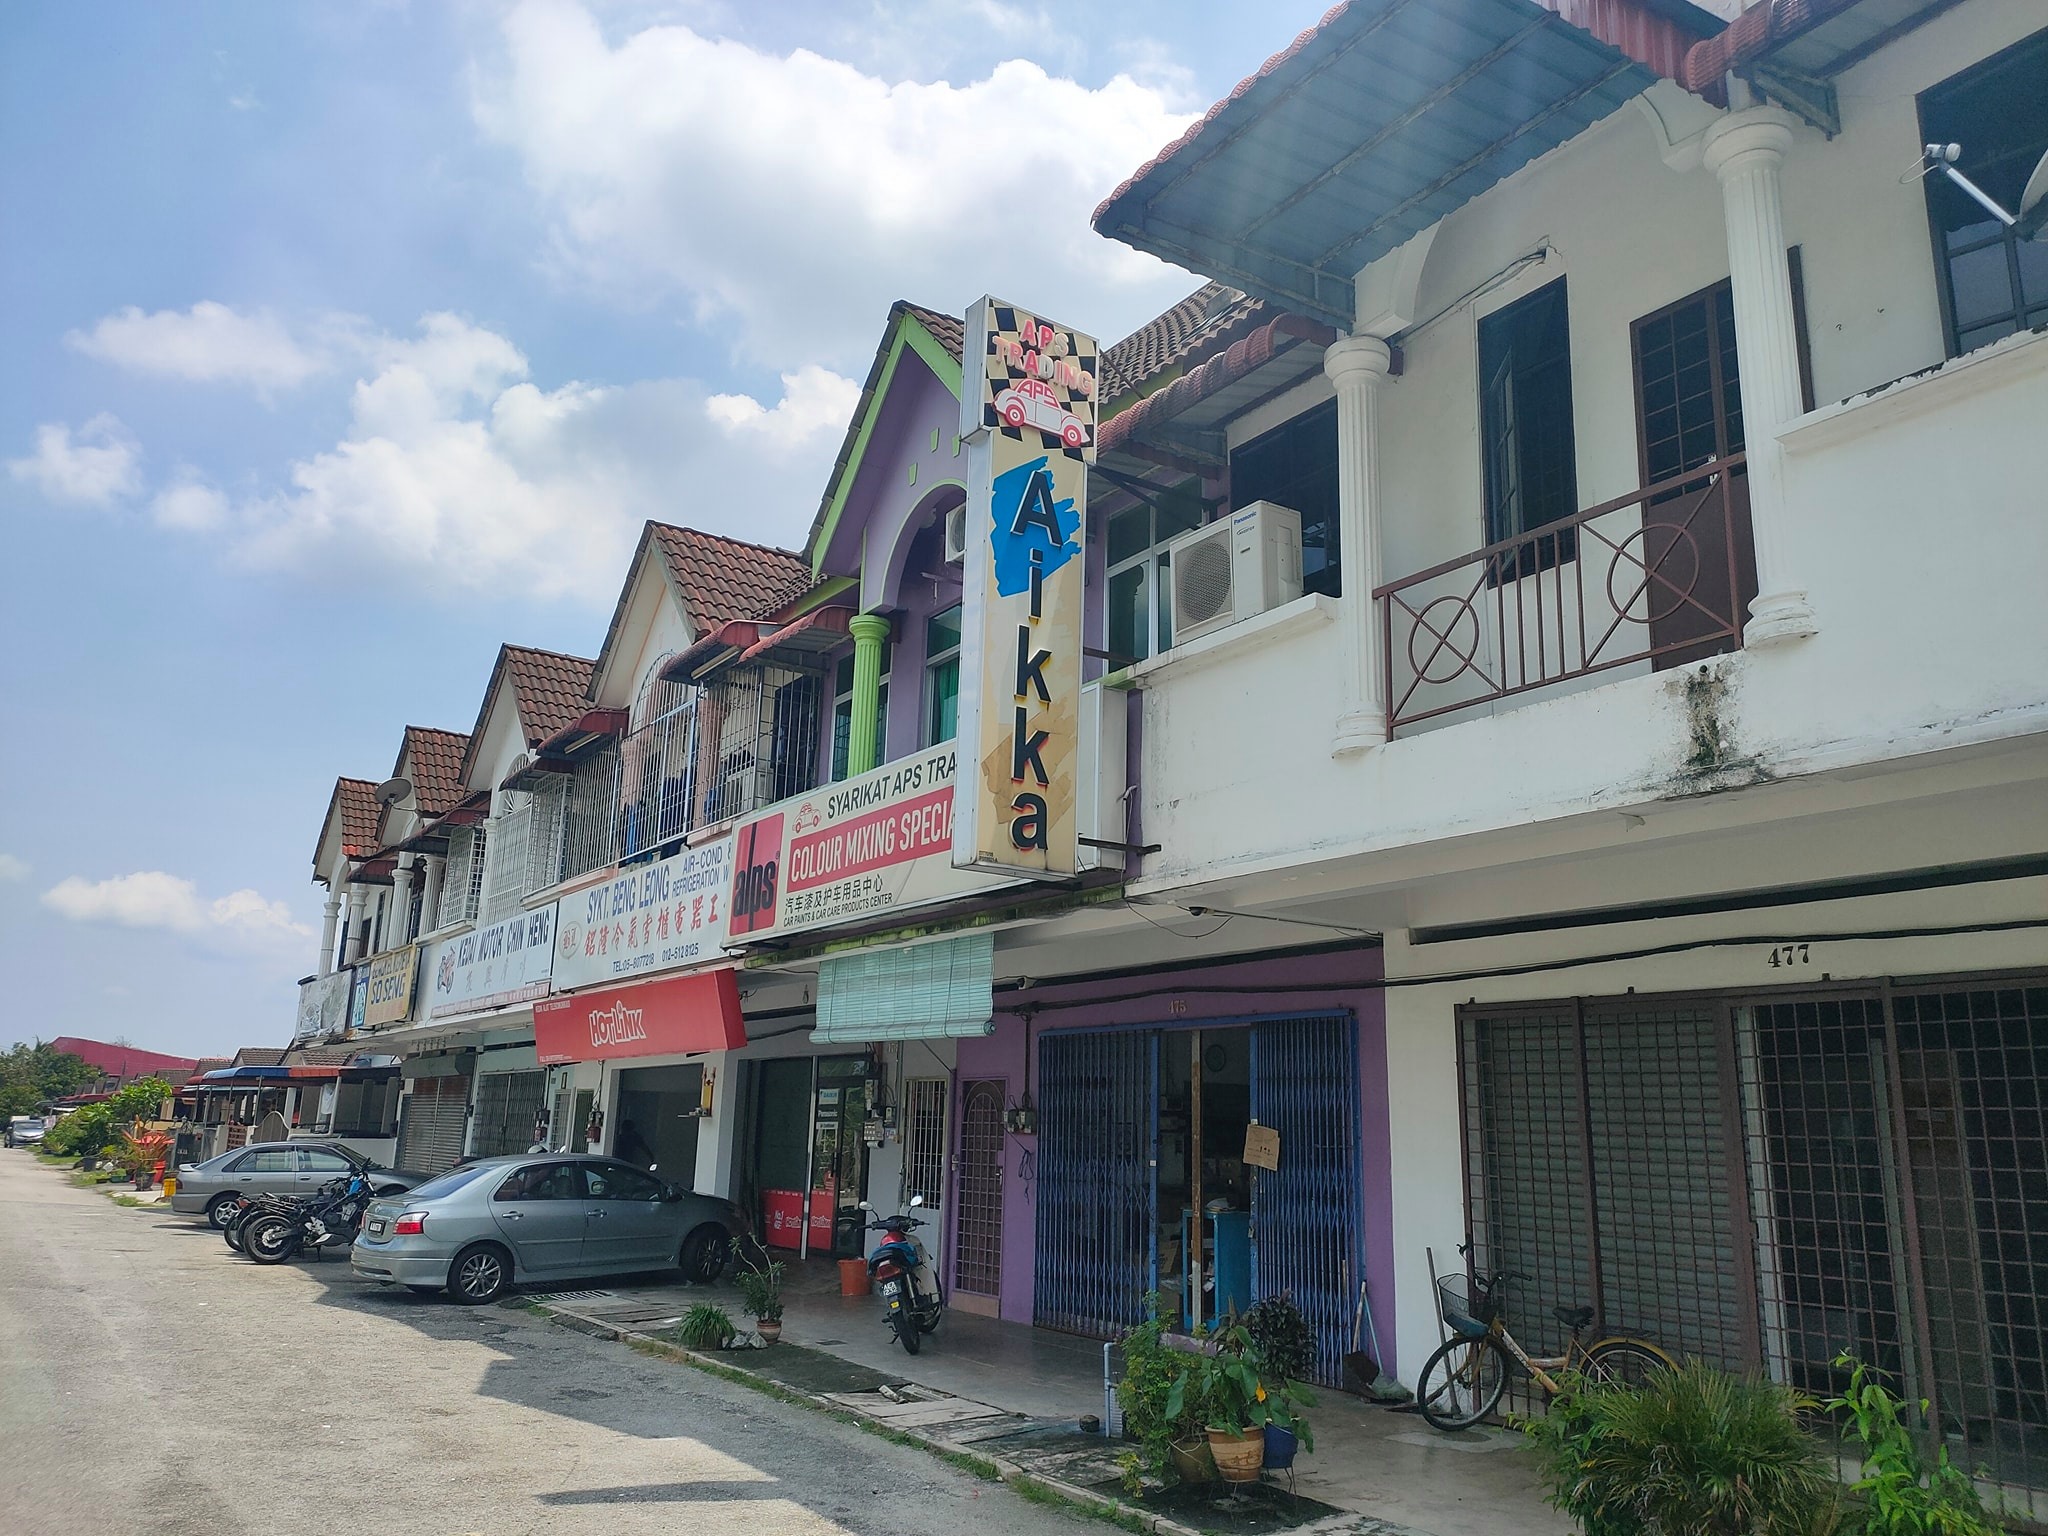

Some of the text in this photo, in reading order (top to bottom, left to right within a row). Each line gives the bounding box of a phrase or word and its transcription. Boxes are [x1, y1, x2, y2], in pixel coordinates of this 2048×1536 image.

[1020, 319, 1069, 358] APS
[992, 335, 1093, 395] TRADING
[1017, 379, 1060, 409] APS
[1233, 511, 1257, 525] Panasonic
[1010, 469, 1064, 852] Aikka
[828, 775, 891, 819] SYARIKAT
[891, 764, 922, 797] APS
[683, 845, 723, 876] AIR-COND
[791, 834, 843, 882] COLOUR
[845, 817, 895, 867] MIXING
[612, 876, 637, 917] BENG
[638, 864, 670, 909] LEONG
[672, 866, 720, 899] REFRIGERATION
[733, 861, 777, 922] alps
[784, 873, 884, 915] 汽车漆及护车用品中心
[783, 916, 794, 928] CAR
[794, 911, 811, 925] PAINTS
[815, 909, 827, 919] CAR
[826, 904, 841, 917] CARE
[841, 898, 870, 915] PRODUCTS
[870, 892, 893, 908] CENTER
[457, 934, 479, 969] KEDAI
[478, 925, 504, 962] MOTOR
[527, 908, 550, 949] HENG
[1767, 944, 1810, 968] 477
[383, 972, 407, 1002] SENG
